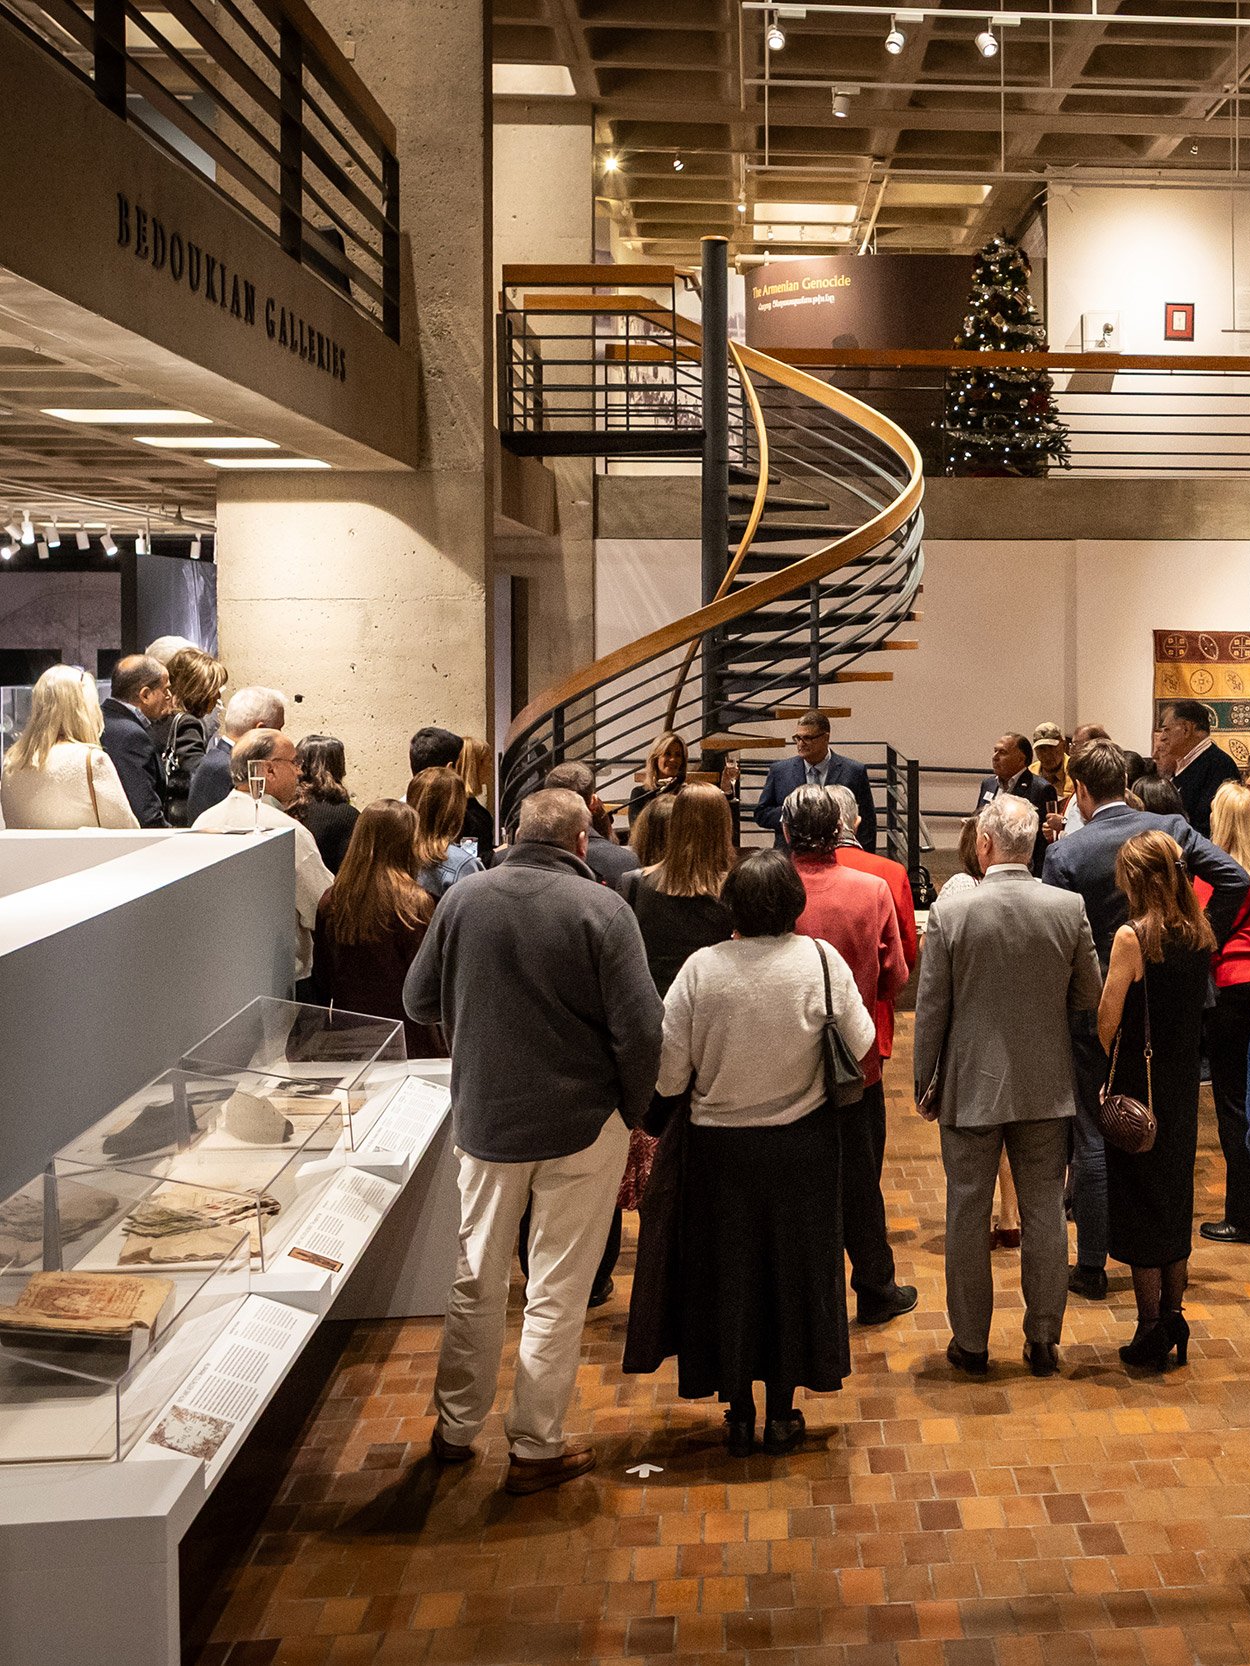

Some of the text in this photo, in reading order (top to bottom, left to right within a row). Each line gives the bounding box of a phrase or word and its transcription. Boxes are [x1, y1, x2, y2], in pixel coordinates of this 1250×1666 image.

[117, 192, 346, 382] BEDOUKIAN GALLERIES
[752, 275, 851, 299] The Armenian Genocide
